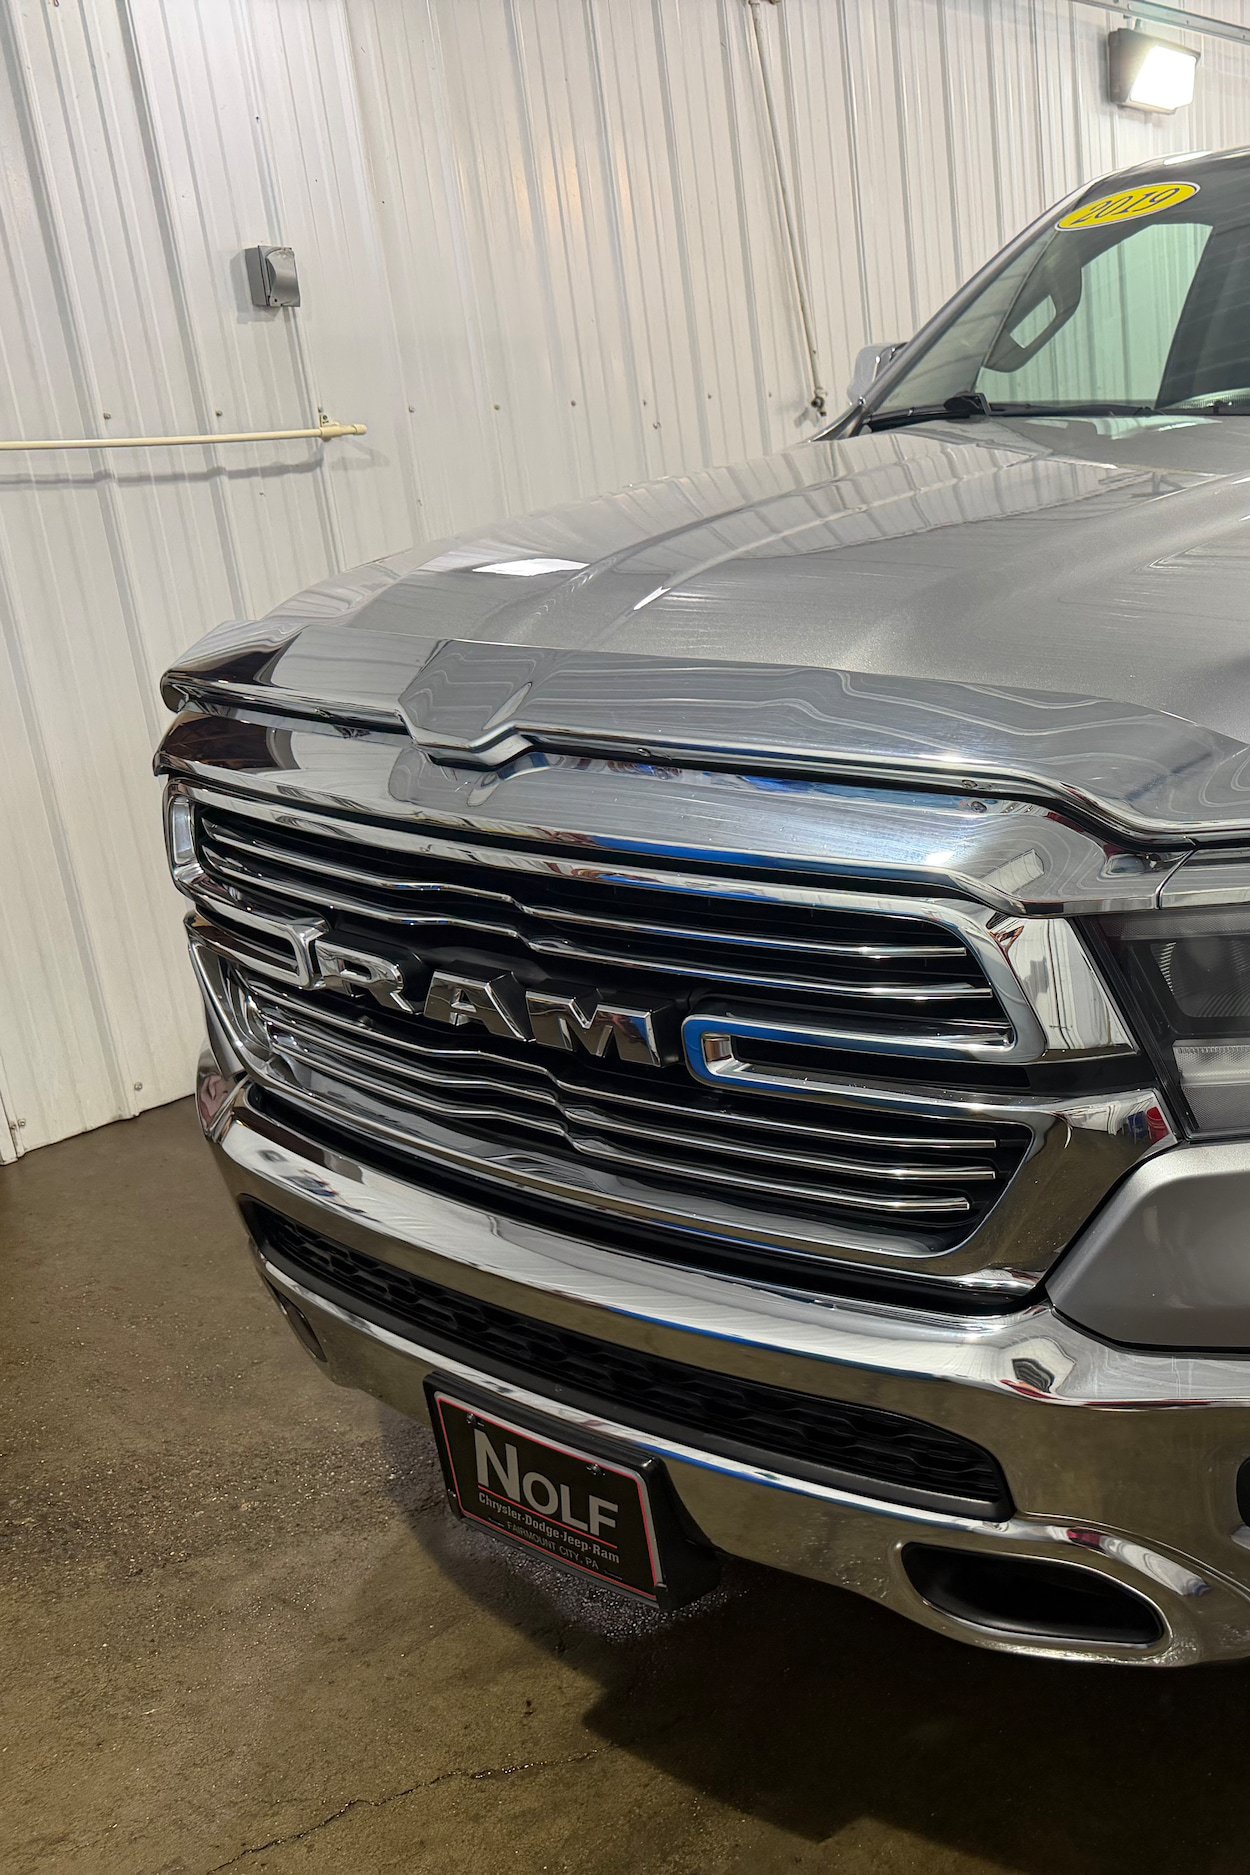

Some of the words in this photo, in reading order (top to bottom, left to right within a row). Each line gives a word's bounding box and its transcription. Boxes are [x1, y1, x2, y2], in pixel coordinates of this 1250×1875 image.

[1071, 187, 1181, 225] 2019
[314, 938, 664, 1067] RAM
[474, 1429, 619, 1536] NOLF
[507, 1521, 557, 1551] FAIRMOUNT
[585, 1557, 600, 1571] PA
